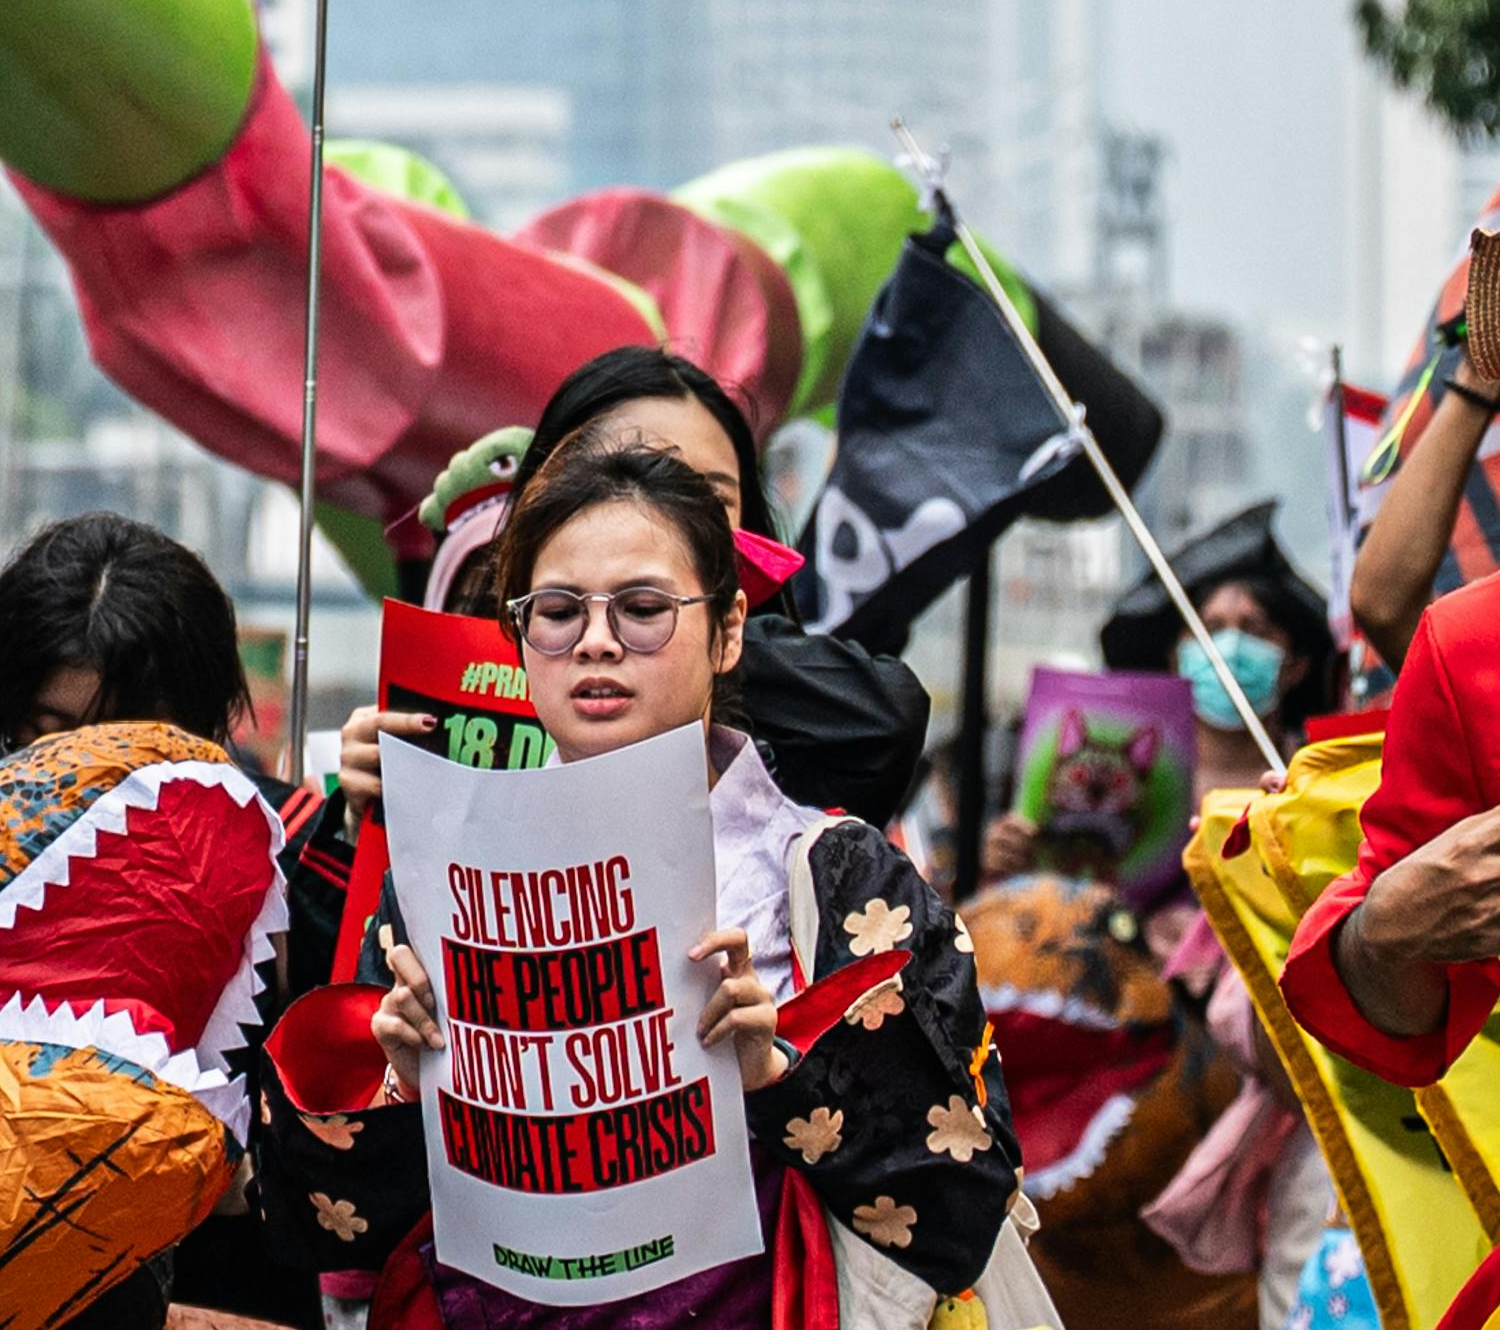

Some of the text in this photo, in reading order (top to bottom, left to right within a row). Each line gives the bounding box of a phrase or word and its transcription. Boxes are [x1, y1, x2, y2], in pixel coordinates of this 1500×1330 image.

[444, 713, 498, 770] 18
[448, 855, 635, 948] SILENCING
[448, 935, 657, 1030] THE PEOPLE
[450, 1009, 681, 1111] WON'T SOLVE
[443, 1084, 708, 1193] CLIMATE CRISIS
[493, 1235, 675, 1280] DRAW THE LINE
